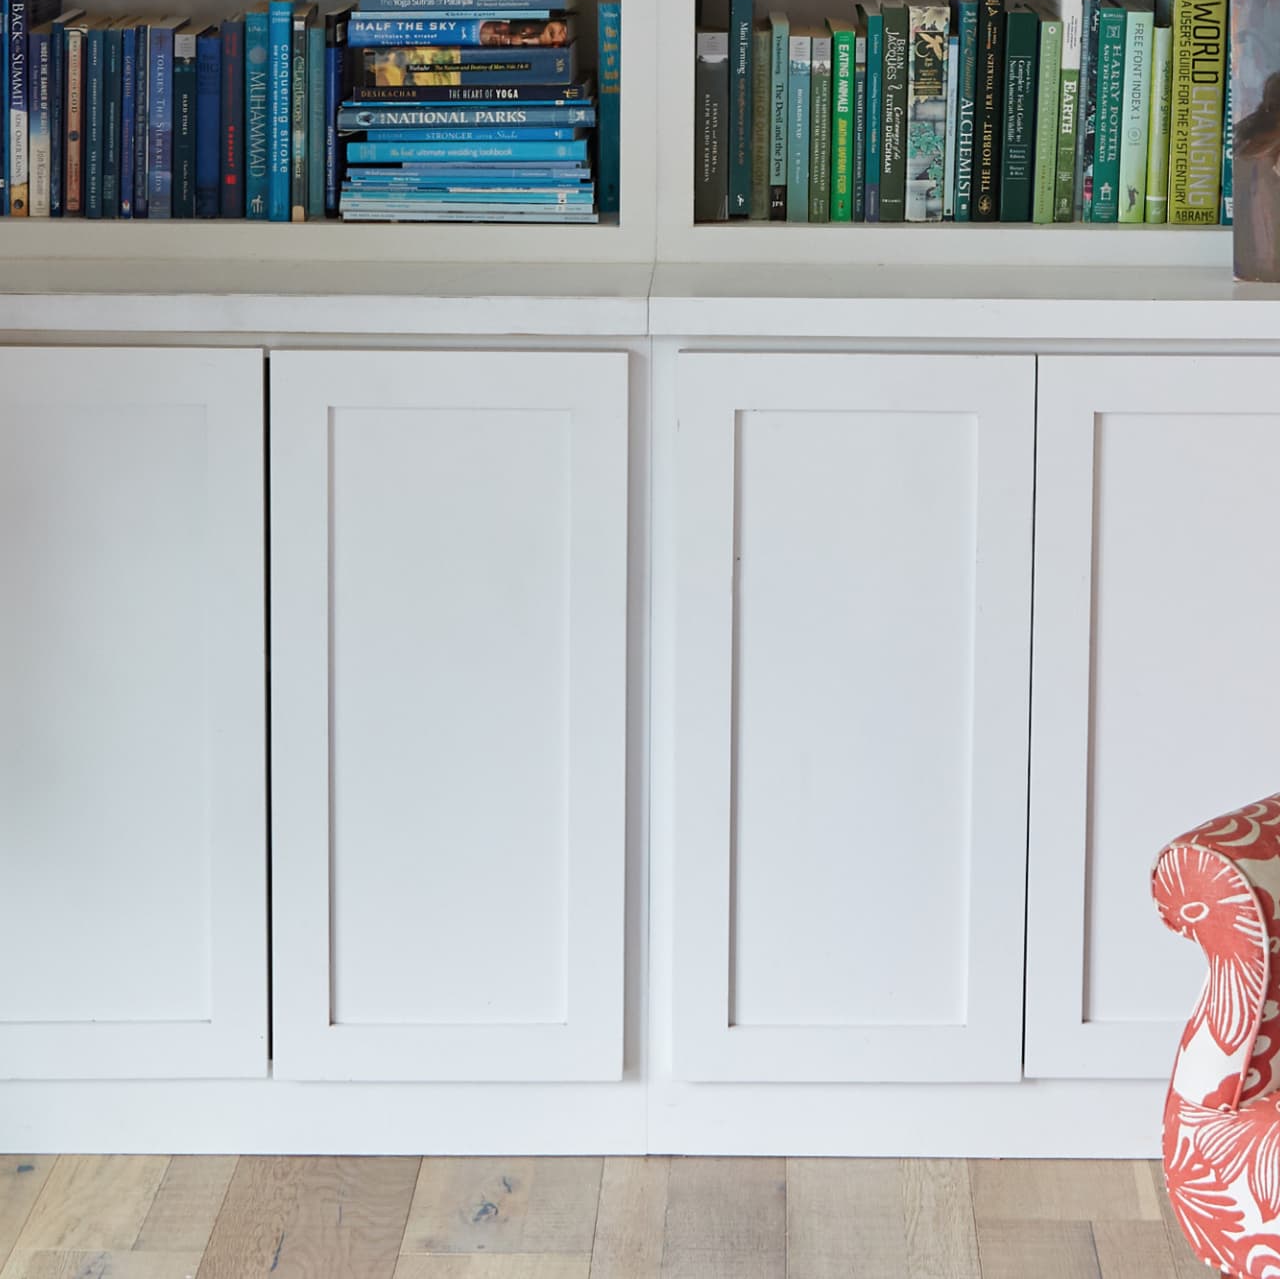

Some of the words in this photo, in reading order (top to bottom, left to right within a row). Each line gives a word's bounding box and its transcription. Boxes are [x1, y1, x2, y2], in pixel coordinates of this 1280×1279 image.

[12, 3, 25, 40] BACK
[355, 23, 392, 31] HALF
[397, 23, 425, 31] THE
[429, 23, 456, 31] SKY
[737, 22, 748, 40] Mini
[1135, 24, 1144, 46] FREE
[1180, 10, 1191, 47] USER'S
[737, 42, 748, 74] Farming
[837, 45, 849, 77] EATING
[886, 28, 898, 79] JACQUES
[897, 39, 905, 69] BRIAN
[1133, 50, 1143, 77] FONT
[1179, 50, 1190, 81] GUIDE
[12, 54, 25, 107] SUMMIT
[279, 44, 289, 122] conquering
[1111, 44, 1122, 102] HARRY
[449, 89, 460, 99] THE
[462, 89, 480, 99] HEART
[483, 89, 492, 99] OF
[496, 89, 518, 99] YOGA
[837, 80, 849, 112] ANIMALS
[1063, 80, 1076, 134] EARTH
[1132, 80, 1141, 111] INDEX
[1178, 84, 1189, 105] FOR
[250, 72, 265, 176] MUHAMMAD
[387, 111, 466, 123] NATIONAL
[475, 111, 526, 123] PARKS
[1177, 108, 1188, 127] THE
[959, 97, 975, 200] ALCHEMIST
[1107, 107, 1119, 161] POTTER
[1176, 130, 1187, 155] 21ST
[279, 130, 289, 173] stroke
[1175, 158, 1187, 203] CENTURY
[1175, 210, 1214, 222] ABRAMS
